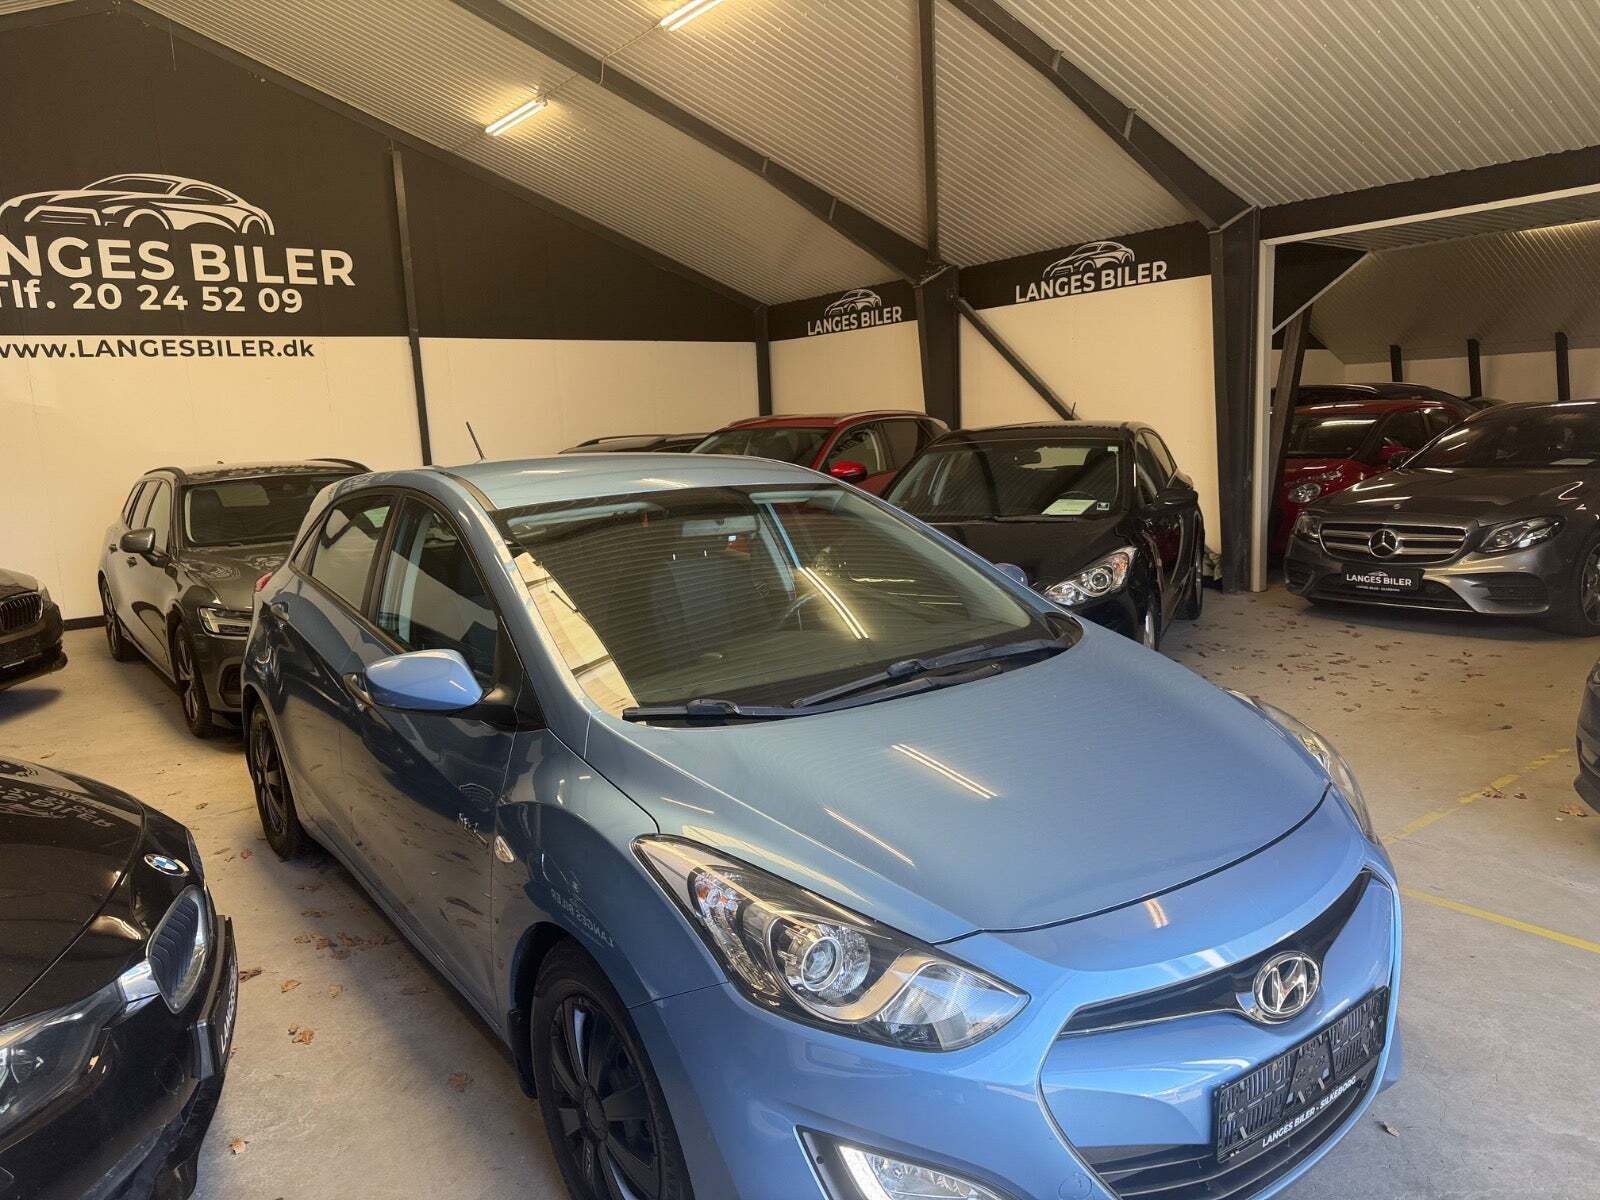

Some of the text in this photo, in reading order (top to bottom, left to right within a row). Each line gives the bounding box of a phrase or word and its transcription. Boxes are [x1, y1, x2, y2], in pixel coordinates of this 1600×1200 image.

[190, 242, 356, 287] BILER
[1015, 260, 1168, 303] LANGES BILER
[69, 283, 122, 310] 20
[137, 285, 188, 311] 24
[202, 287, 245, 312] 52
[258, 288, 303, 313] 09
[807, 306, 902, 336] LANGES BILER
[1346, 574, 1412, 586] LANGES BILER
[1262, 1121, 1293, 1148] LANGES
[1294, 1106, 1315, 1128] BILER
[1320, 1075, 1356, 1109] SILKEBORG
